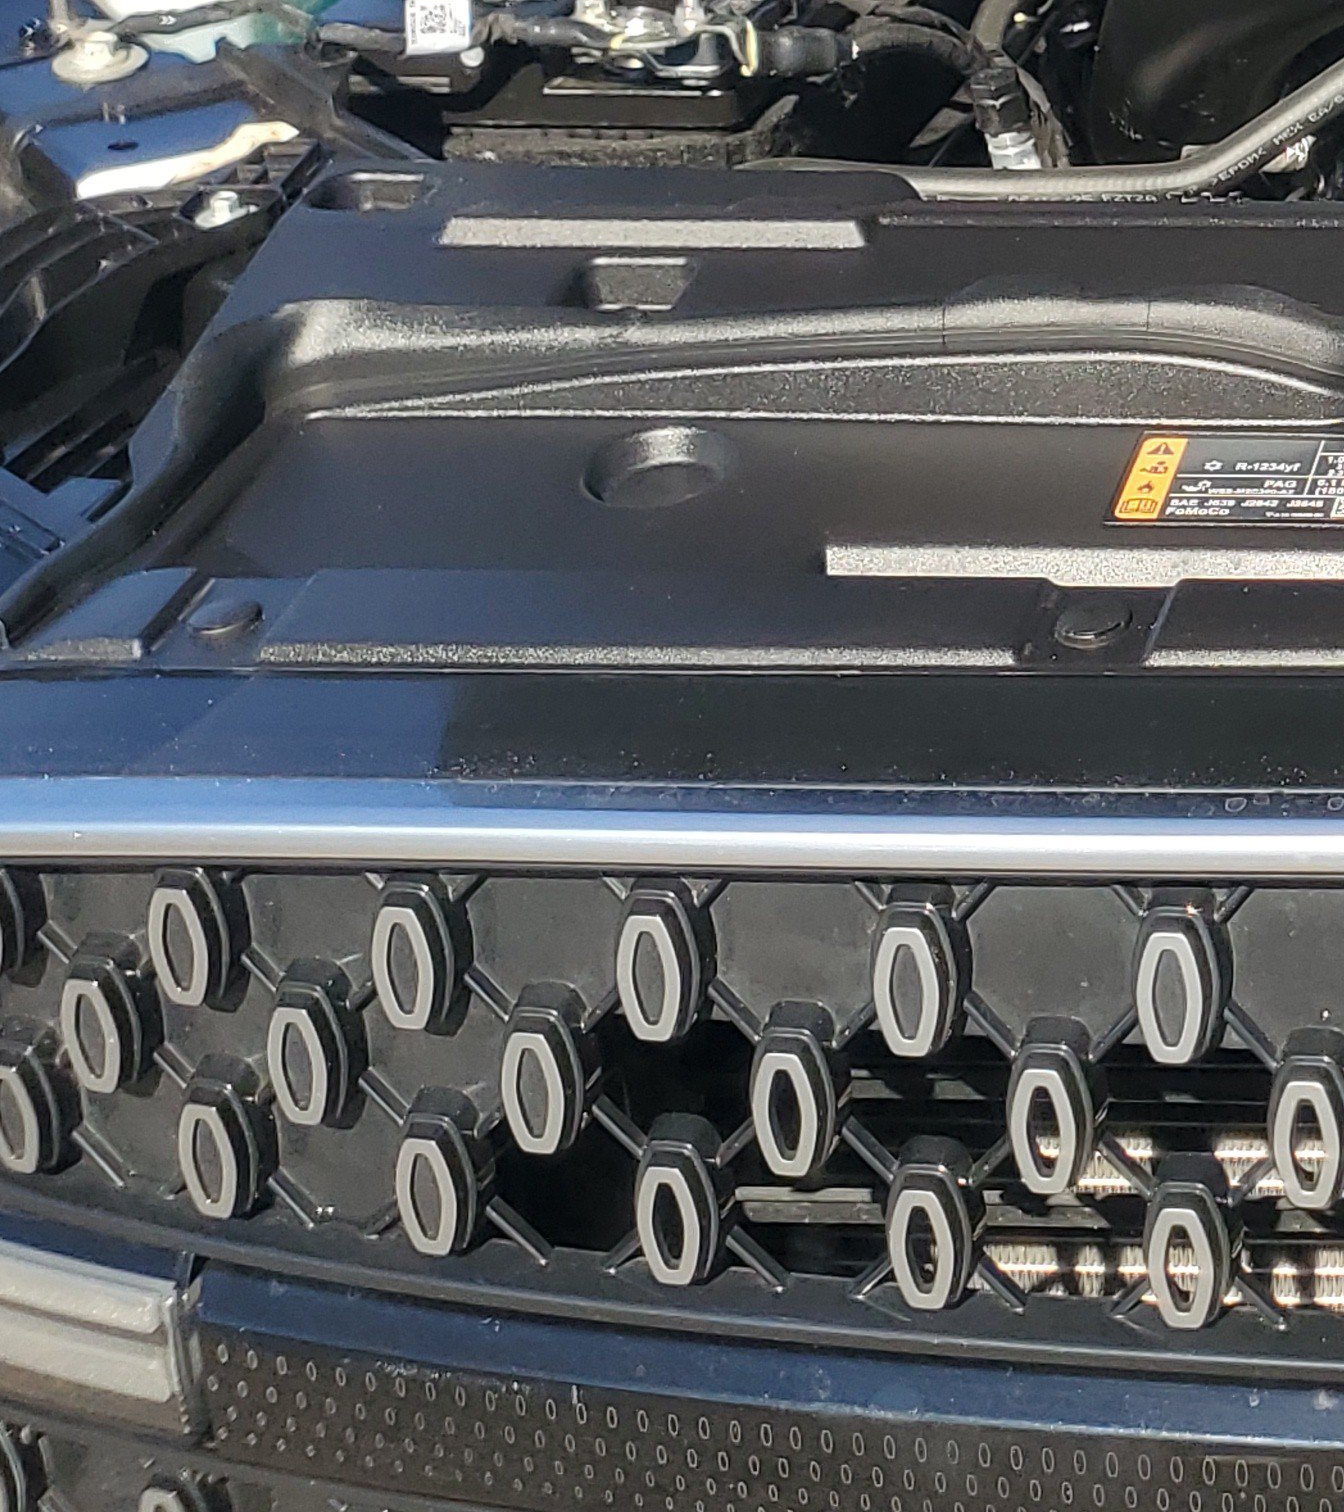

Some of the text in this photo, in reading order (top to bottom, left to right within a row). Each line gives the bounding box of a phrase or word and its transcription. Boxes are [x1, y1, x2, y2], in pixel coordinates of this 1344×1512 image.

[1235, 461, 1302, 472] R-1234yf
[1263, 480, 1298, 488] PAG
[1164, 507, 1230, 516] FoMoCo
